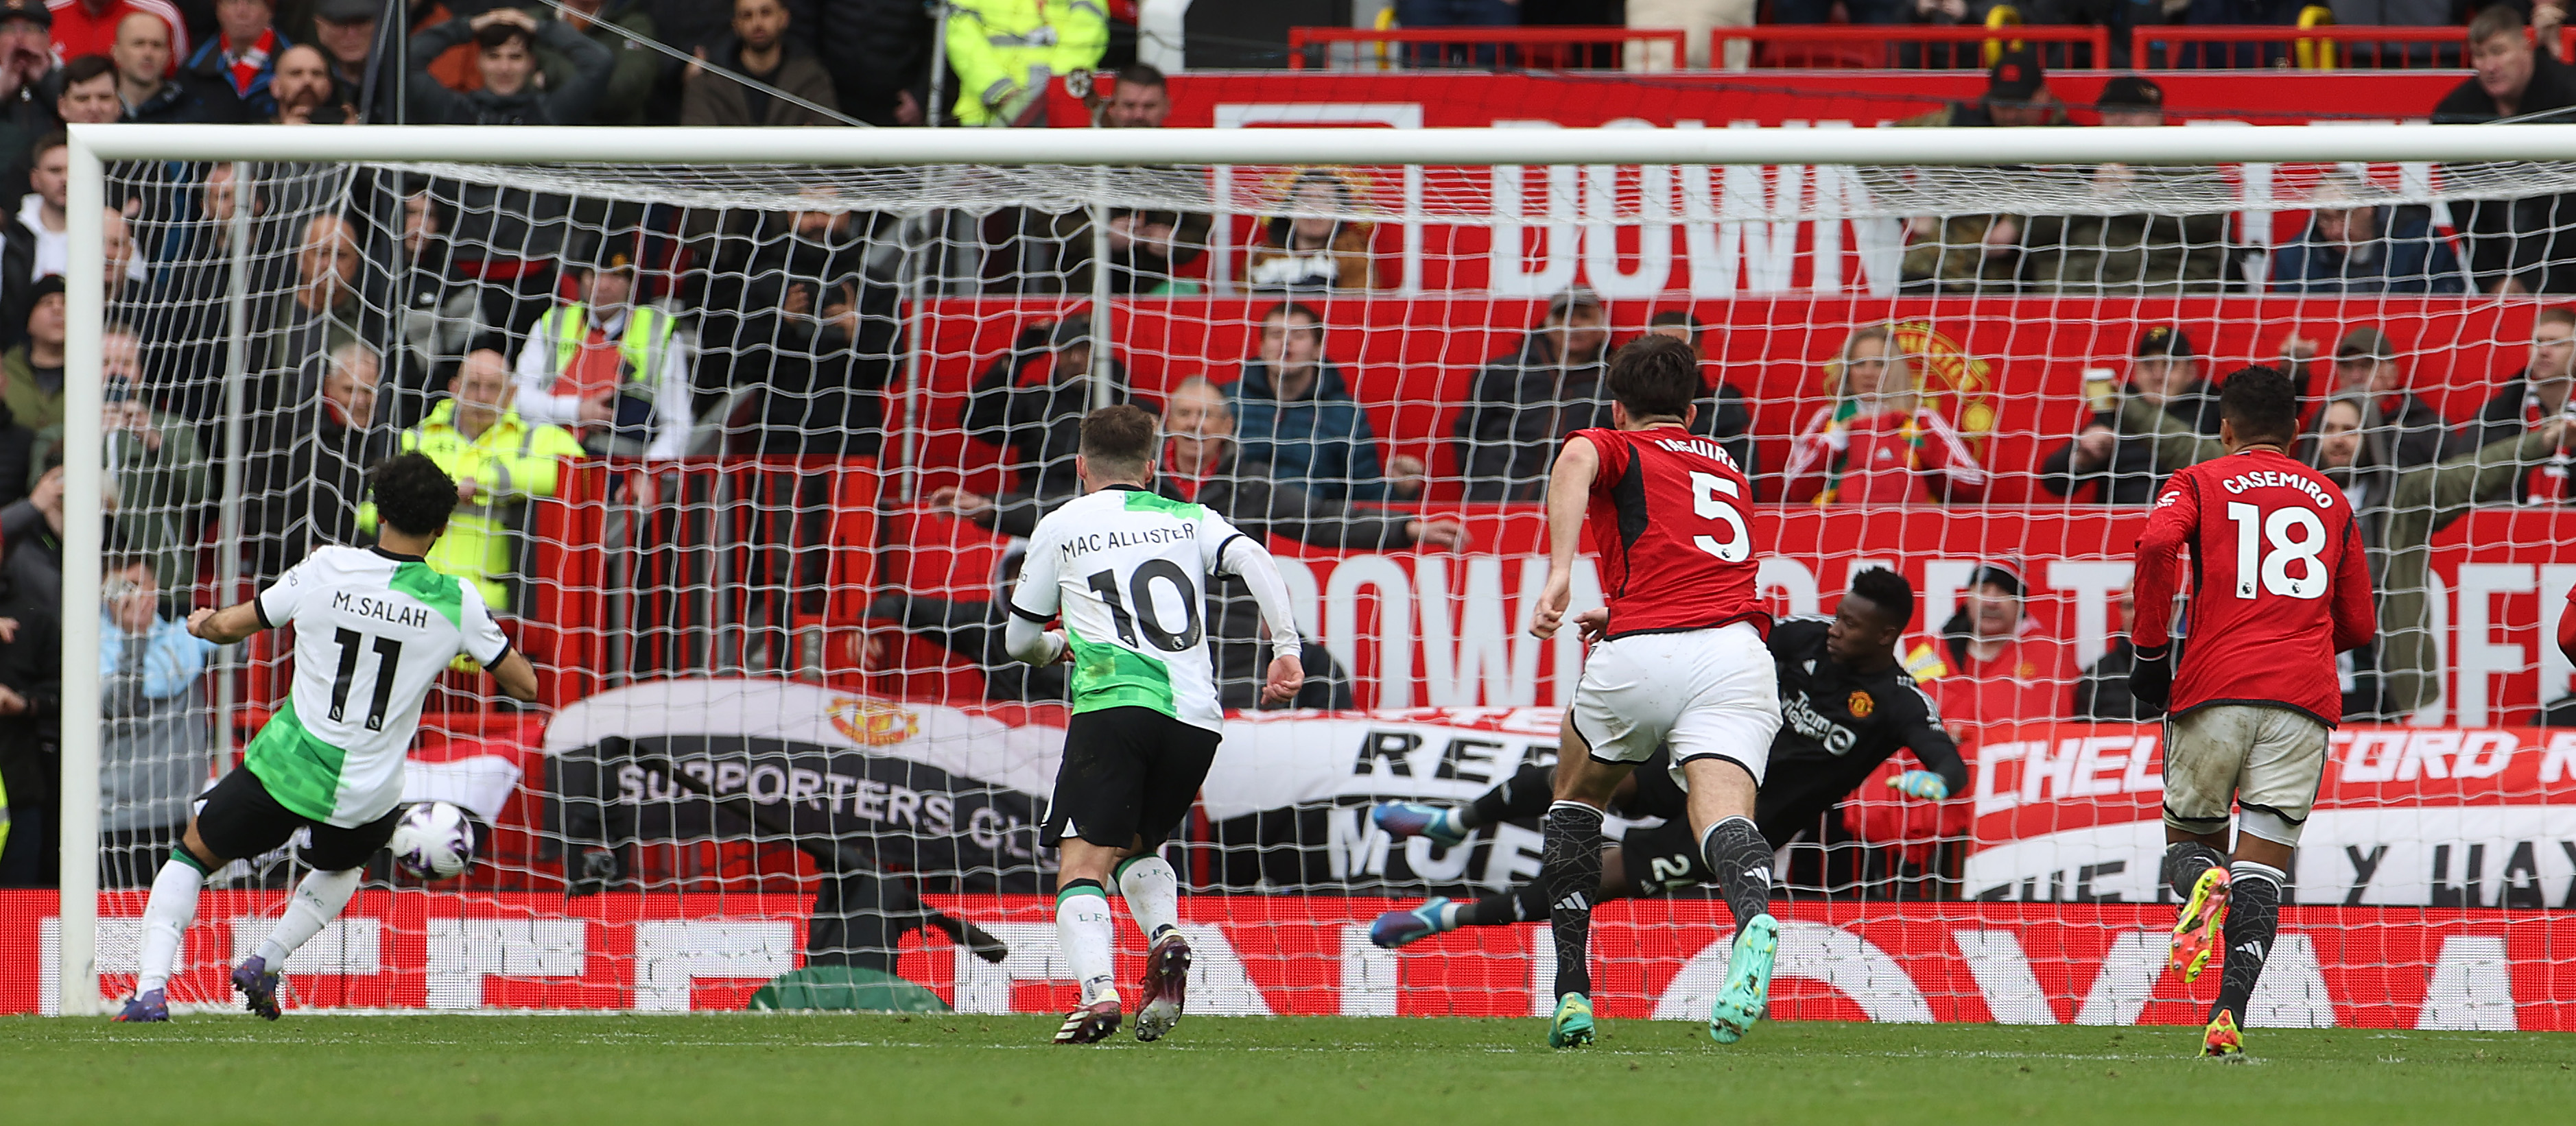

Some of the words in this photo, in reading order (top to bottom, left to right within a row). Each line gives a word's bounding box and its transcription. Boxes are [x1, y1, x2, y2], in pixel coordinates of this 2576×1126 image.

[1689, 470, 1751, 563] 5
[2223, 470, 2334, 509] CASEMIRO
[1061, 534, 1101, 563] MAC
[1108, 523, 1195, 549] ALLISTER
[2227, 501, 2328, 599] 18
[1087, 558, 1201, 651] 10
[328, 627, 402, 732] 11
[617, 760, 952, 837] SUPPORTERS
